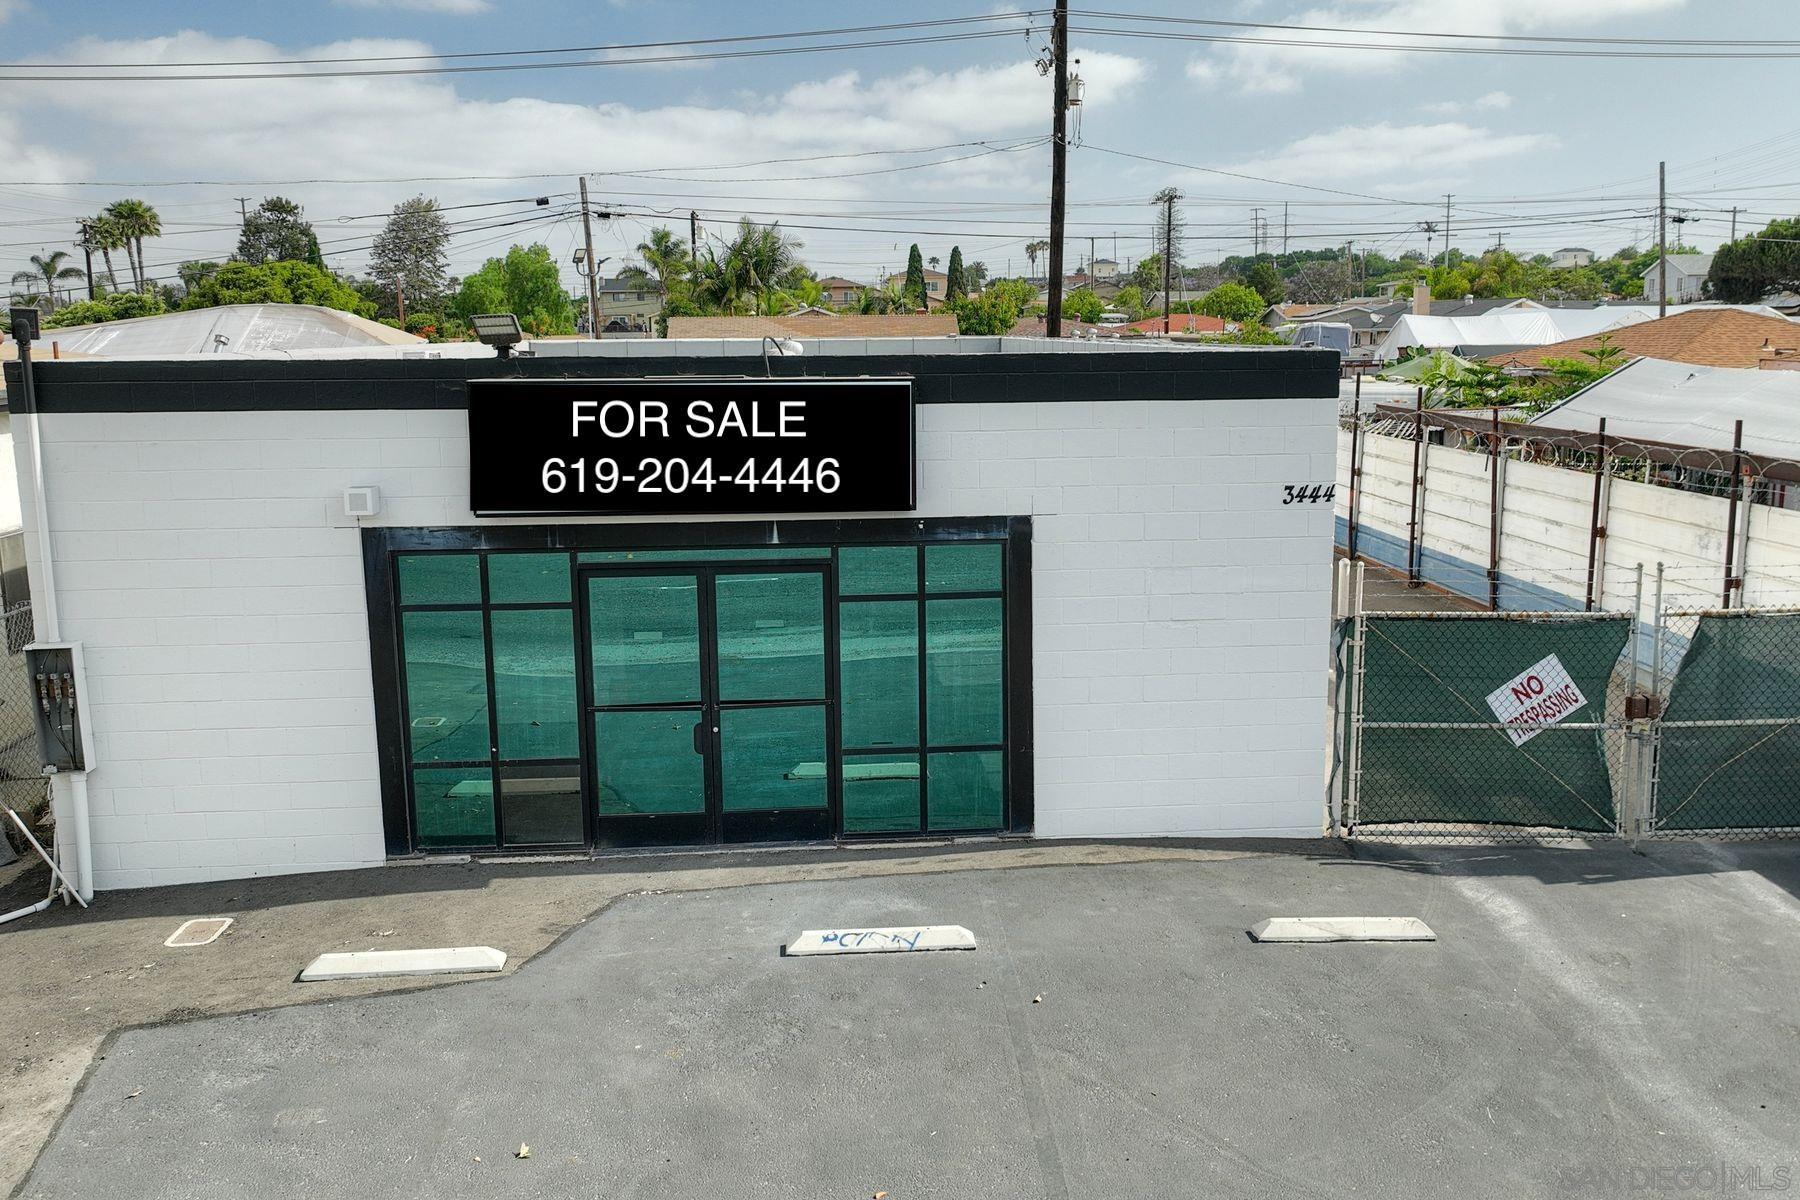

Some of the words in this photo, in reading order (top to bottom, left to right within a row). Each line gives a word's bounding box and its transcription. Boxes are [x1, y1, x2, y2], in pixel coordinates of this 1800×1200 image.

[572, 400, 669, 438] FOR
[686, 400, 807, 438] SALE
[541, 457, 841, 494] 619-204-4446
[1283, 484, 1336, 505] 3444
[1511, 675, 1544, 705] NO
